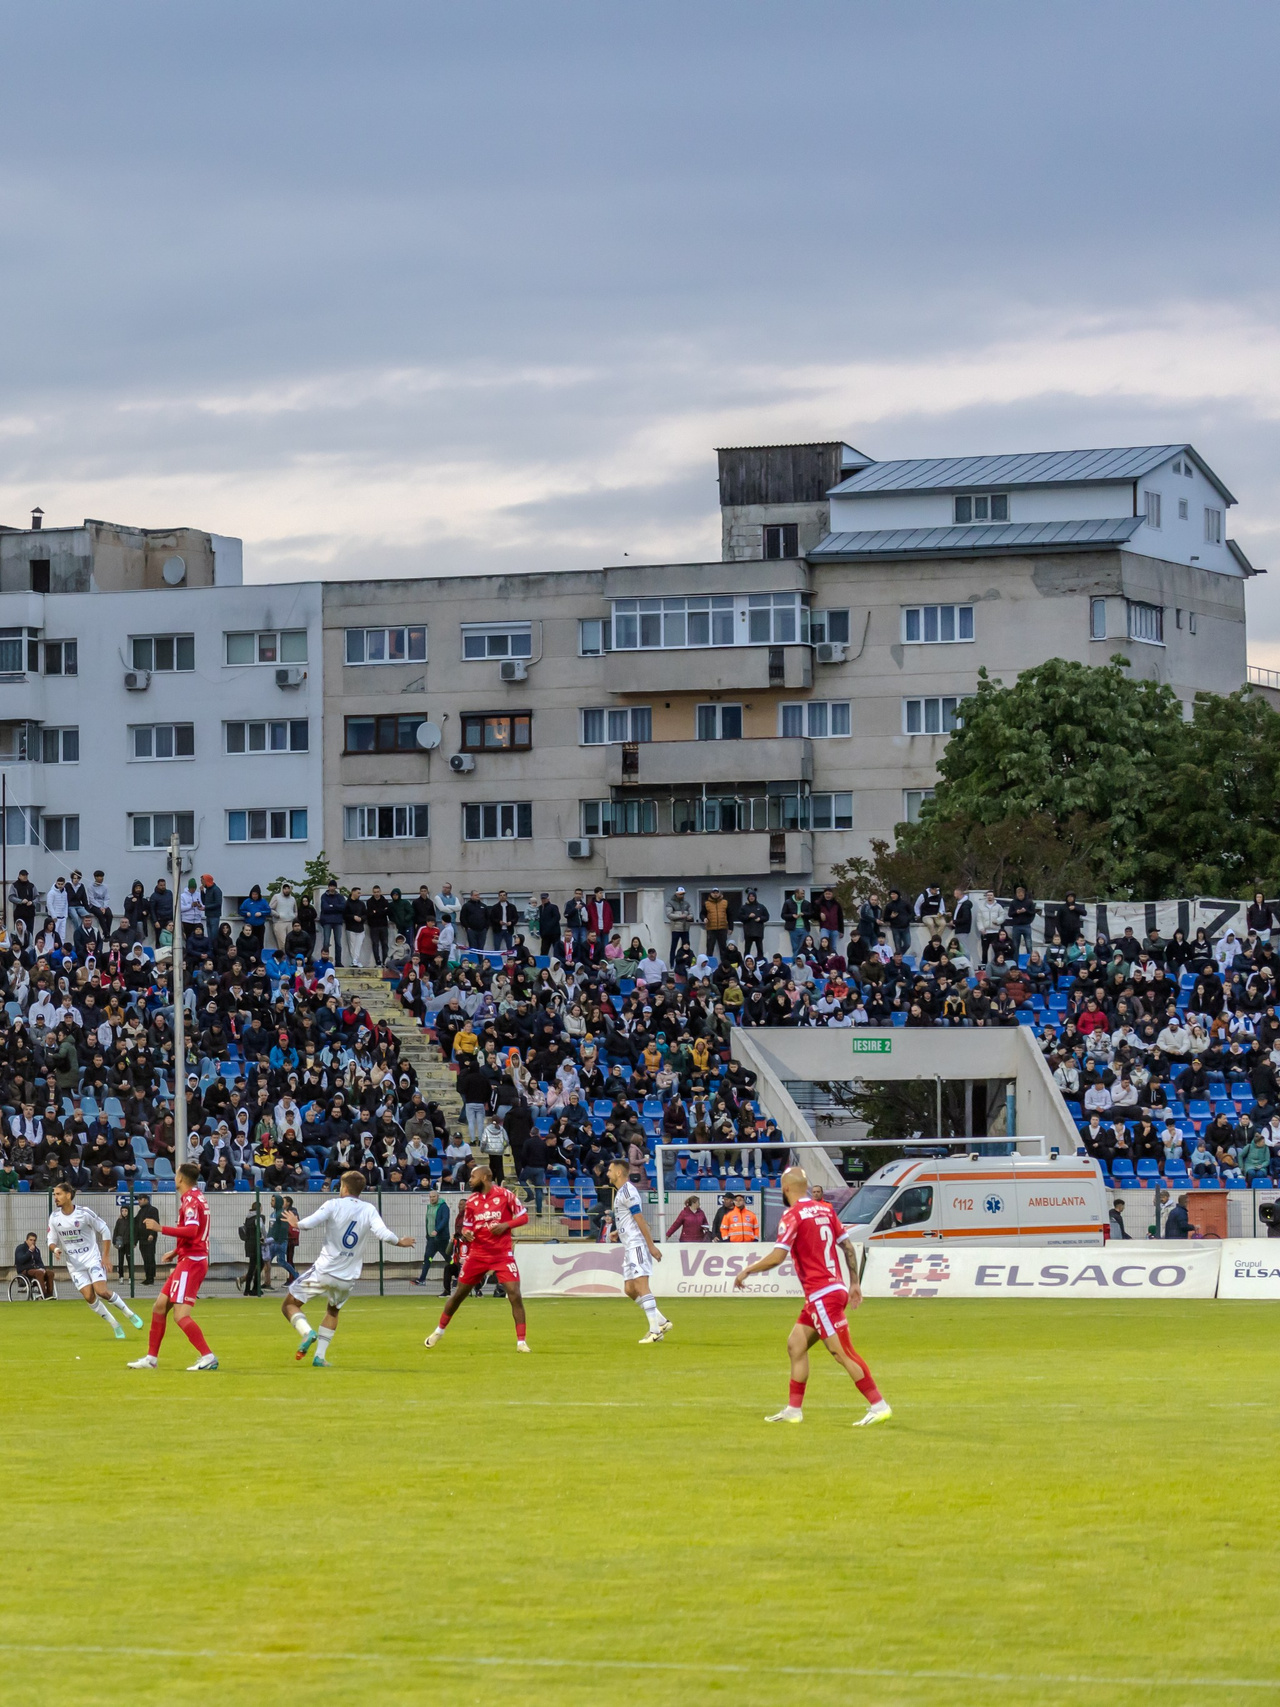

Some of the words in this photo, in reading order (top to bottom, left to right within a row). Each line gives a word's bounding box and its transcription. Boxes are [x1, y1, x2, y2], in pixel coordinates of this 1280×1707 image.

[853, 1039, 882, 1051] IESIRE
[884, 1040, 891, 1051] 2
[957, 1198, 974, 1211] 112
[1028, 1196, 1086, 1207] AMBULANTA
[342, 1221, 358, 1249] 6
[820, 1226, 835, 1268] 2
[507, 1263, 518, 1273] 19
[1234, 1260, 1262, 1269] Grupul
[974, 1265, 1186, 1287] ELSACO
[677, 1282, 727, 1296] Grupul
